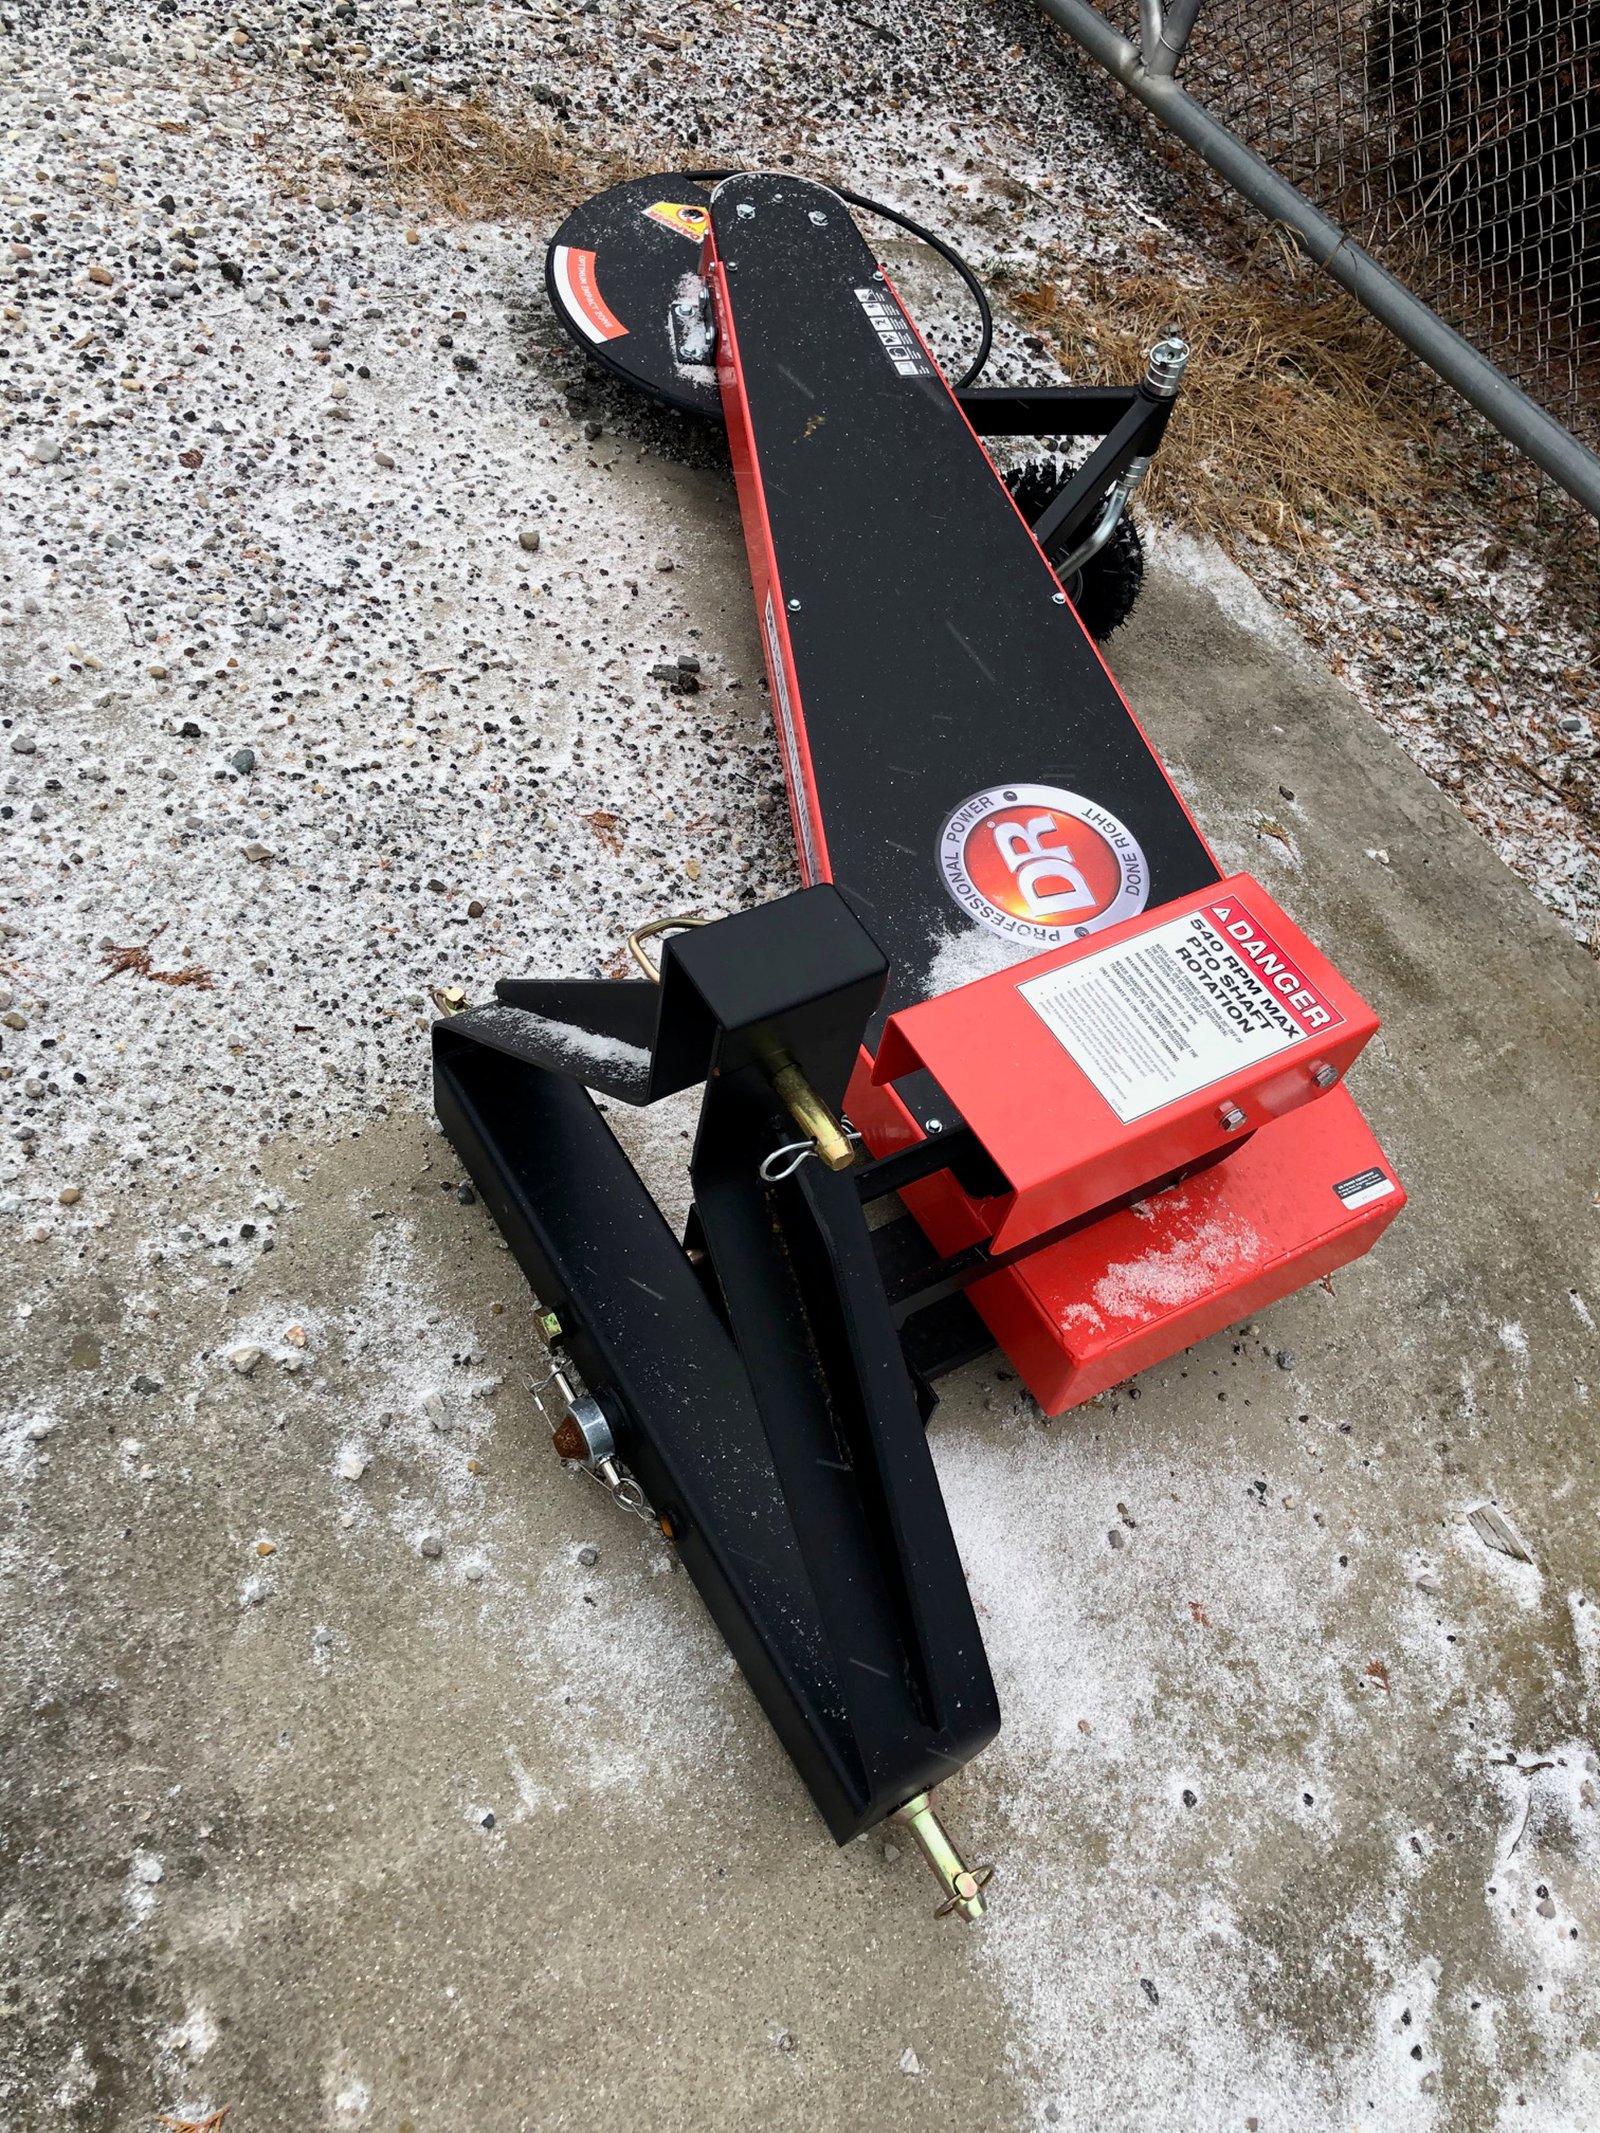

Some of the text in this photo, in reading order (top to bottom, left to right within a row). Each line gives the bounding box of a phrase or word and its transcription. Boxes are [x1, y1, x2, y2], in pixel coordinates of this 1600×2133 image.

[581, 286, 598, 309] IMPACT
[944, 795, 1061, 942] PROFESSIONAL POWER
[991, 813, 1098, 917] DR
[1081, 807, 1142, 897] DONE RIGHT
[1175, 947, 1255, 1033] ROTATION
[1187, 936, 1274, 1030] PTO SHAFT
[1190, 918, 1300, 1039] 540 RPM MAX
[1225, 919, 1332, 1029] DANGER
